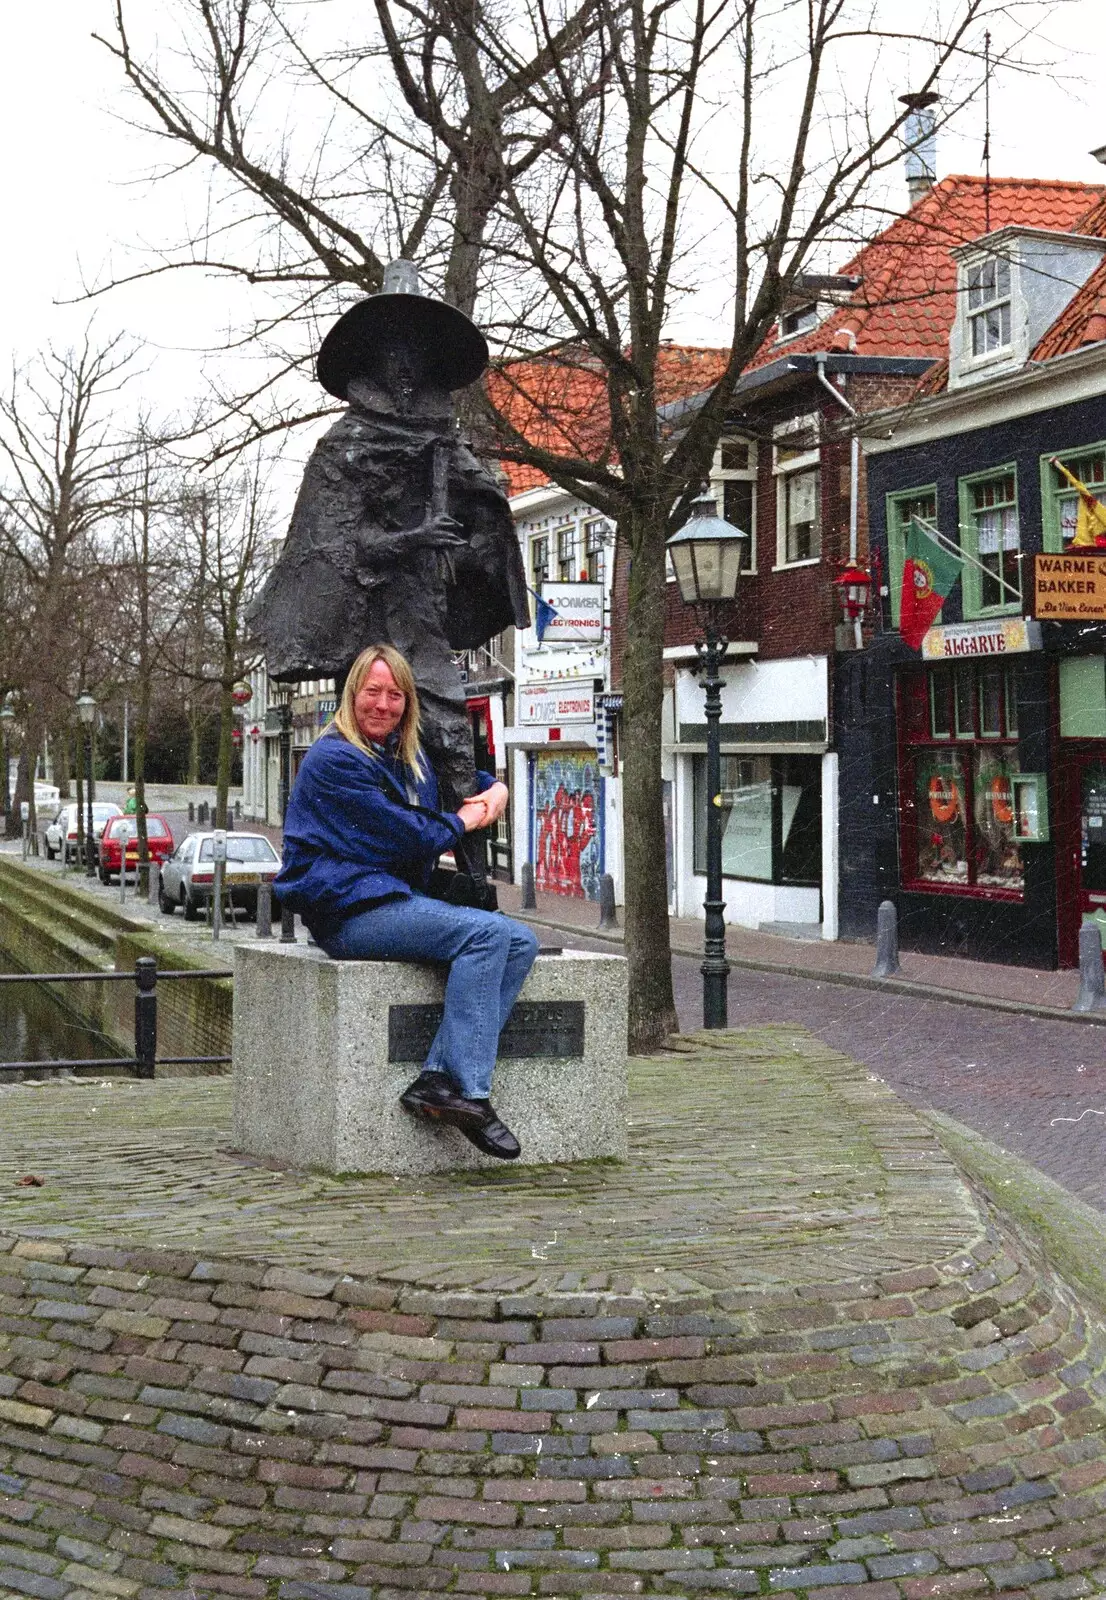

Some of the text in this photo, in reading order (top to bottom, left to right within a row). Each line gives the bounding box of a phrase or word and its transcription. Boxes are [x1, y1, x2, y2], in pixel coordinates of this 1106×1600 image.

[1039, 560, 1095, 573] WARME
[1038, 580, 1095, 593] BAKKER
[944, 634, 1006, 655] ALGARVE
